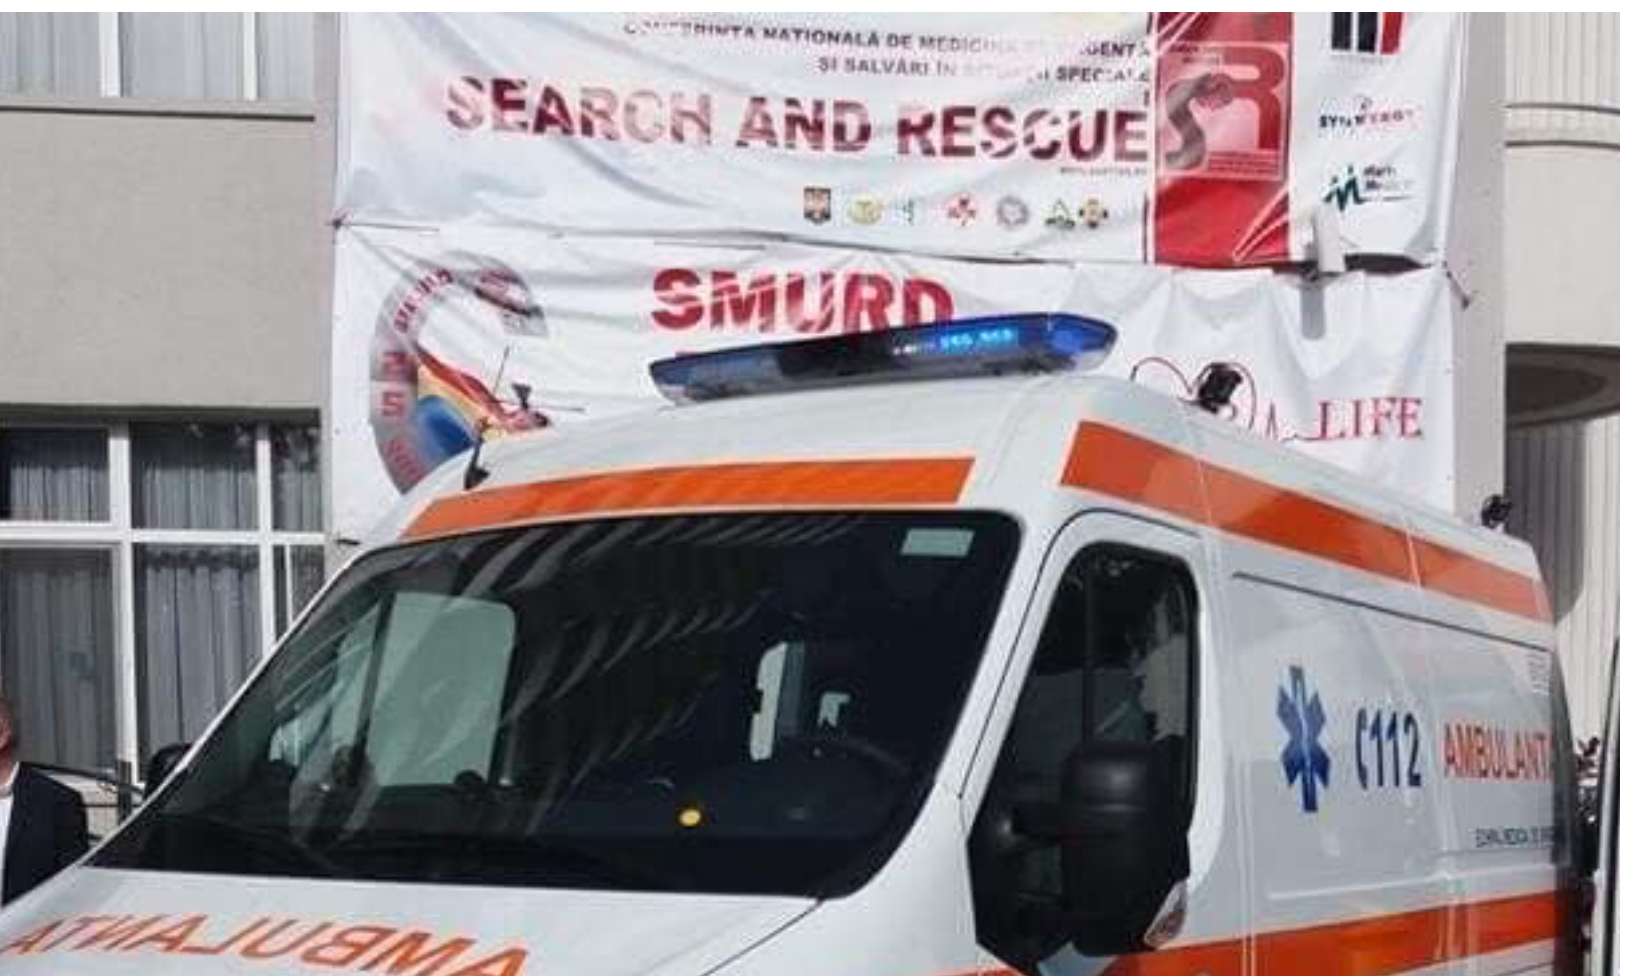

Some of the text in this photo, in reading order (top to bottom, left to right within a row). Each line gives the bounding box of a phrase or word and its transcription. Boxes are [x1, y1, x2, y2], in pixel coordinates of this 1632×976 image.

[446, 75, 1149, 163] SEARCH AND RESCUE
[651, 267, 956, 335] SMURD
[1318, 396, 1424, 440] LIFE
